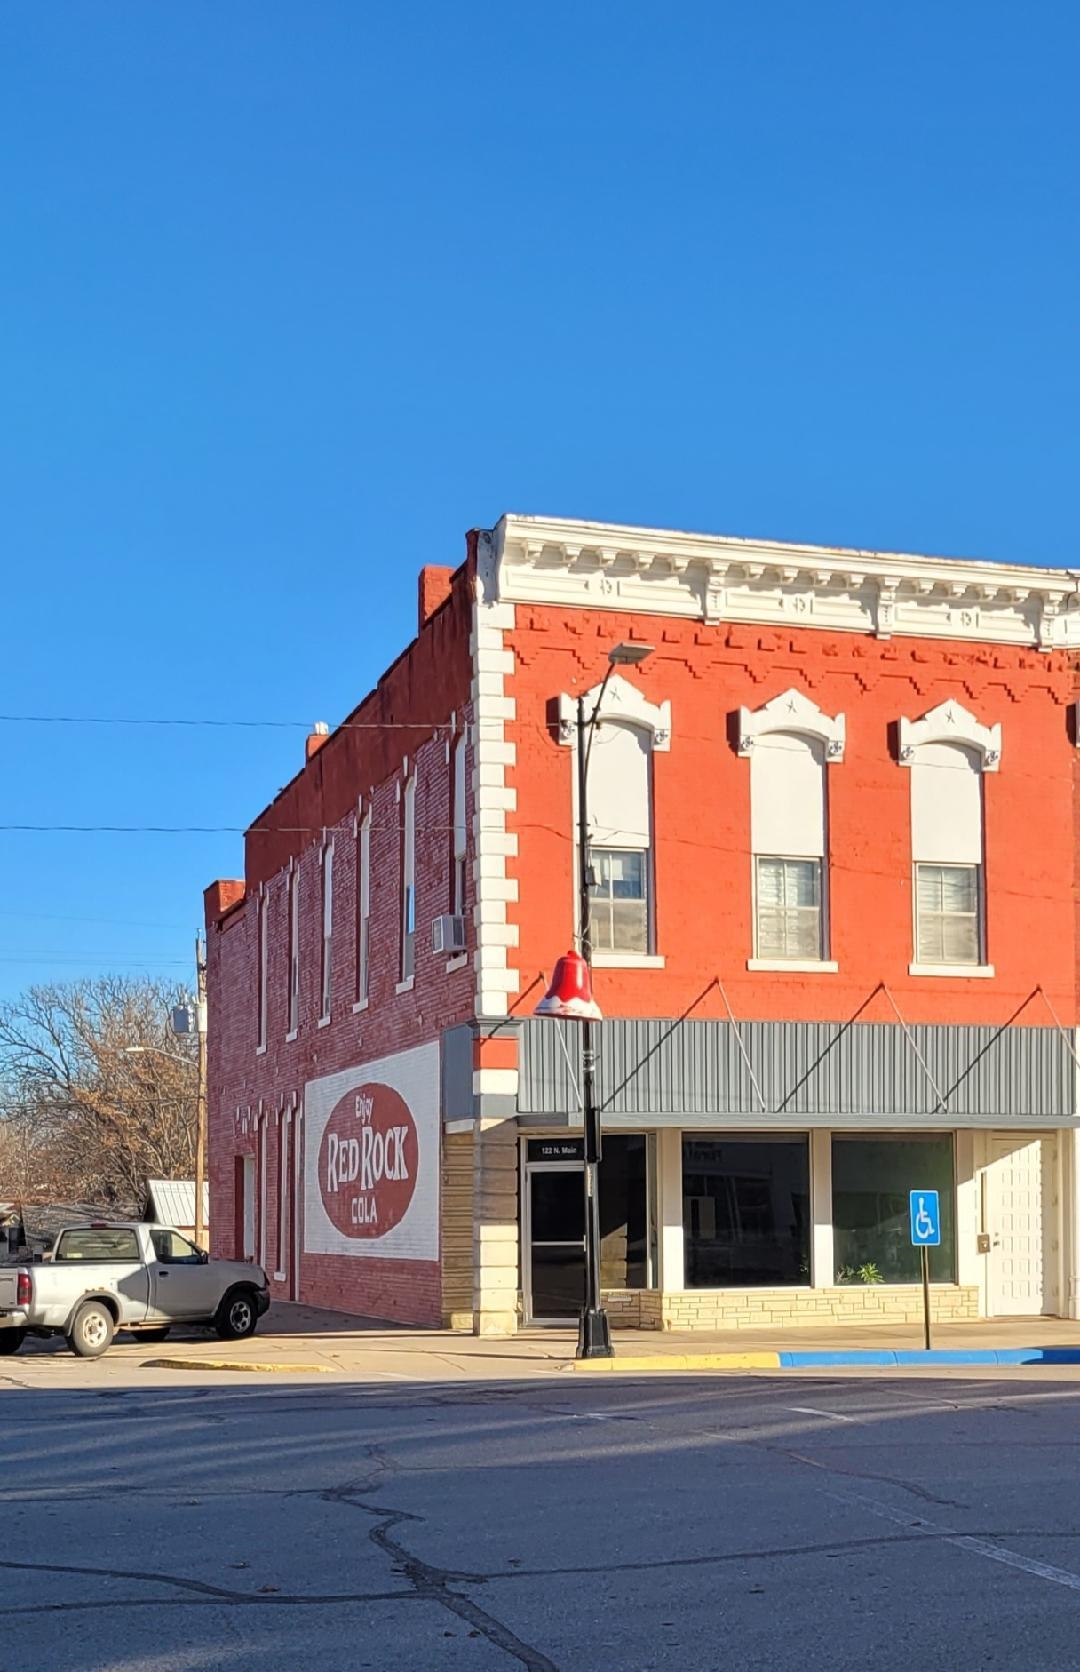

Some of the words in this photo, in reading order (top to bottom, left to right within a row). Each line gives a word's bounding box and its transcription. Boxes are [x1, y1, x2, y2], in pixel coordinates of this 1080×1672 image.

[355, 1093, 374, 1125] Enjoy
[327, 1133, 359, 1192] RED
[361, 1126, 409, 1190] ROCK
[561, 1146, 577, 1154] Main
[352, 1197, 378, 1224] COLA
